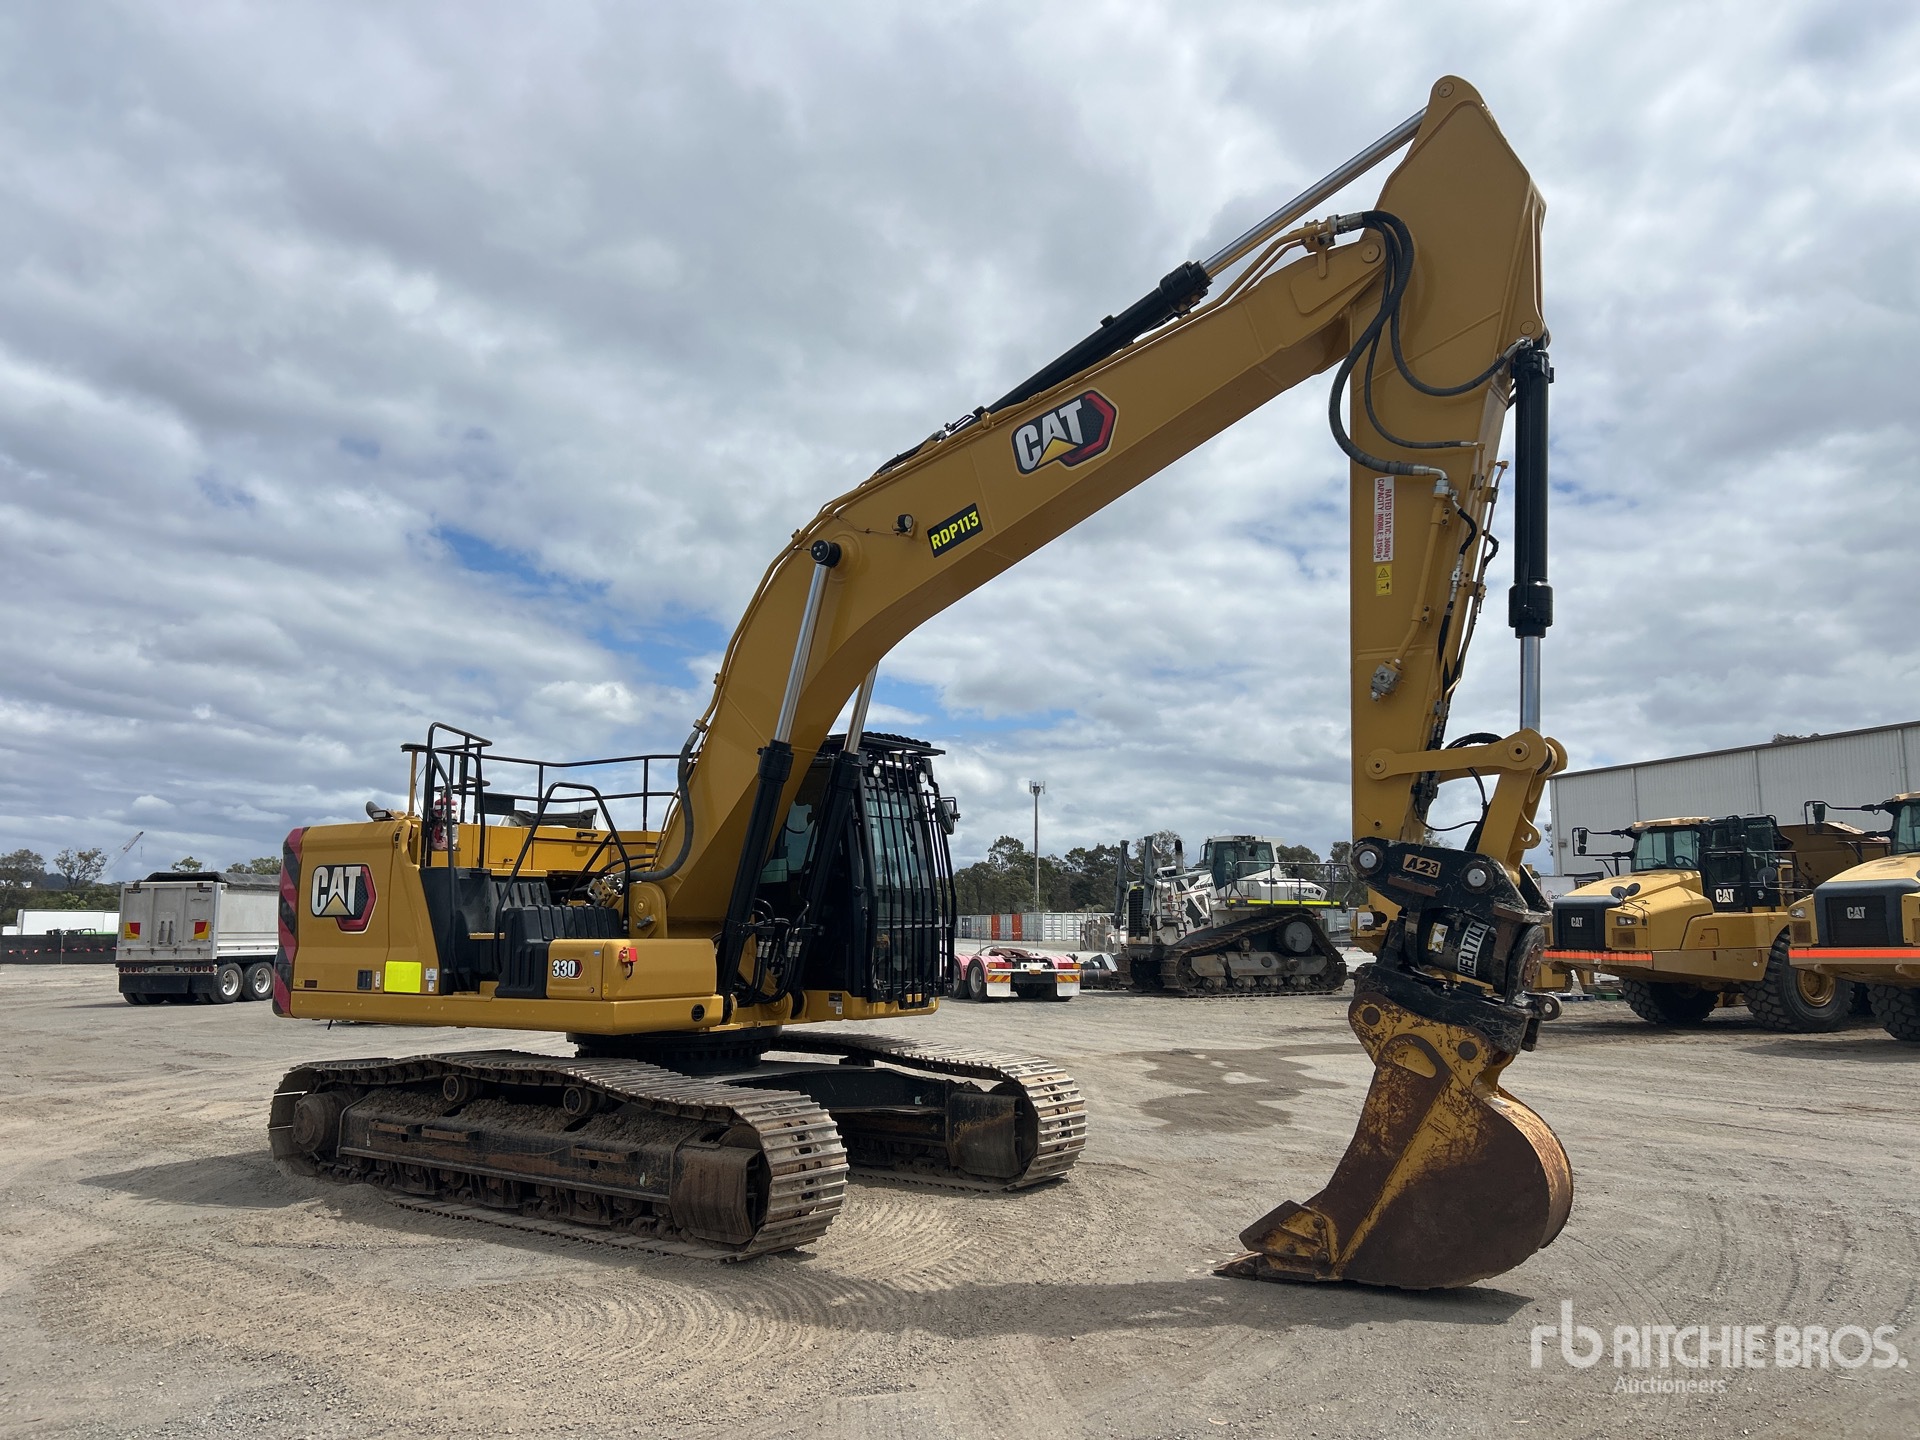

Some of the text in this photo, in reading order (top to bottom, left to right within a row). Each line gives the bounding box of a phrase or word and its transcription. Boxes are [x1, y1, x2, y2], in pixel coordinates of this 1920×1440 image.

[1015, 399, 1083, 470] CAT
[931, 510, 979, 550] RDP113
[311, 866, 362, 915] CAT
[1715, 888, 1734, 903] CAT
[1846, 906, 1866, 919] CAT
[1570, 917, 1583, 927] CAT
[552, 959, 576, 977] 330
